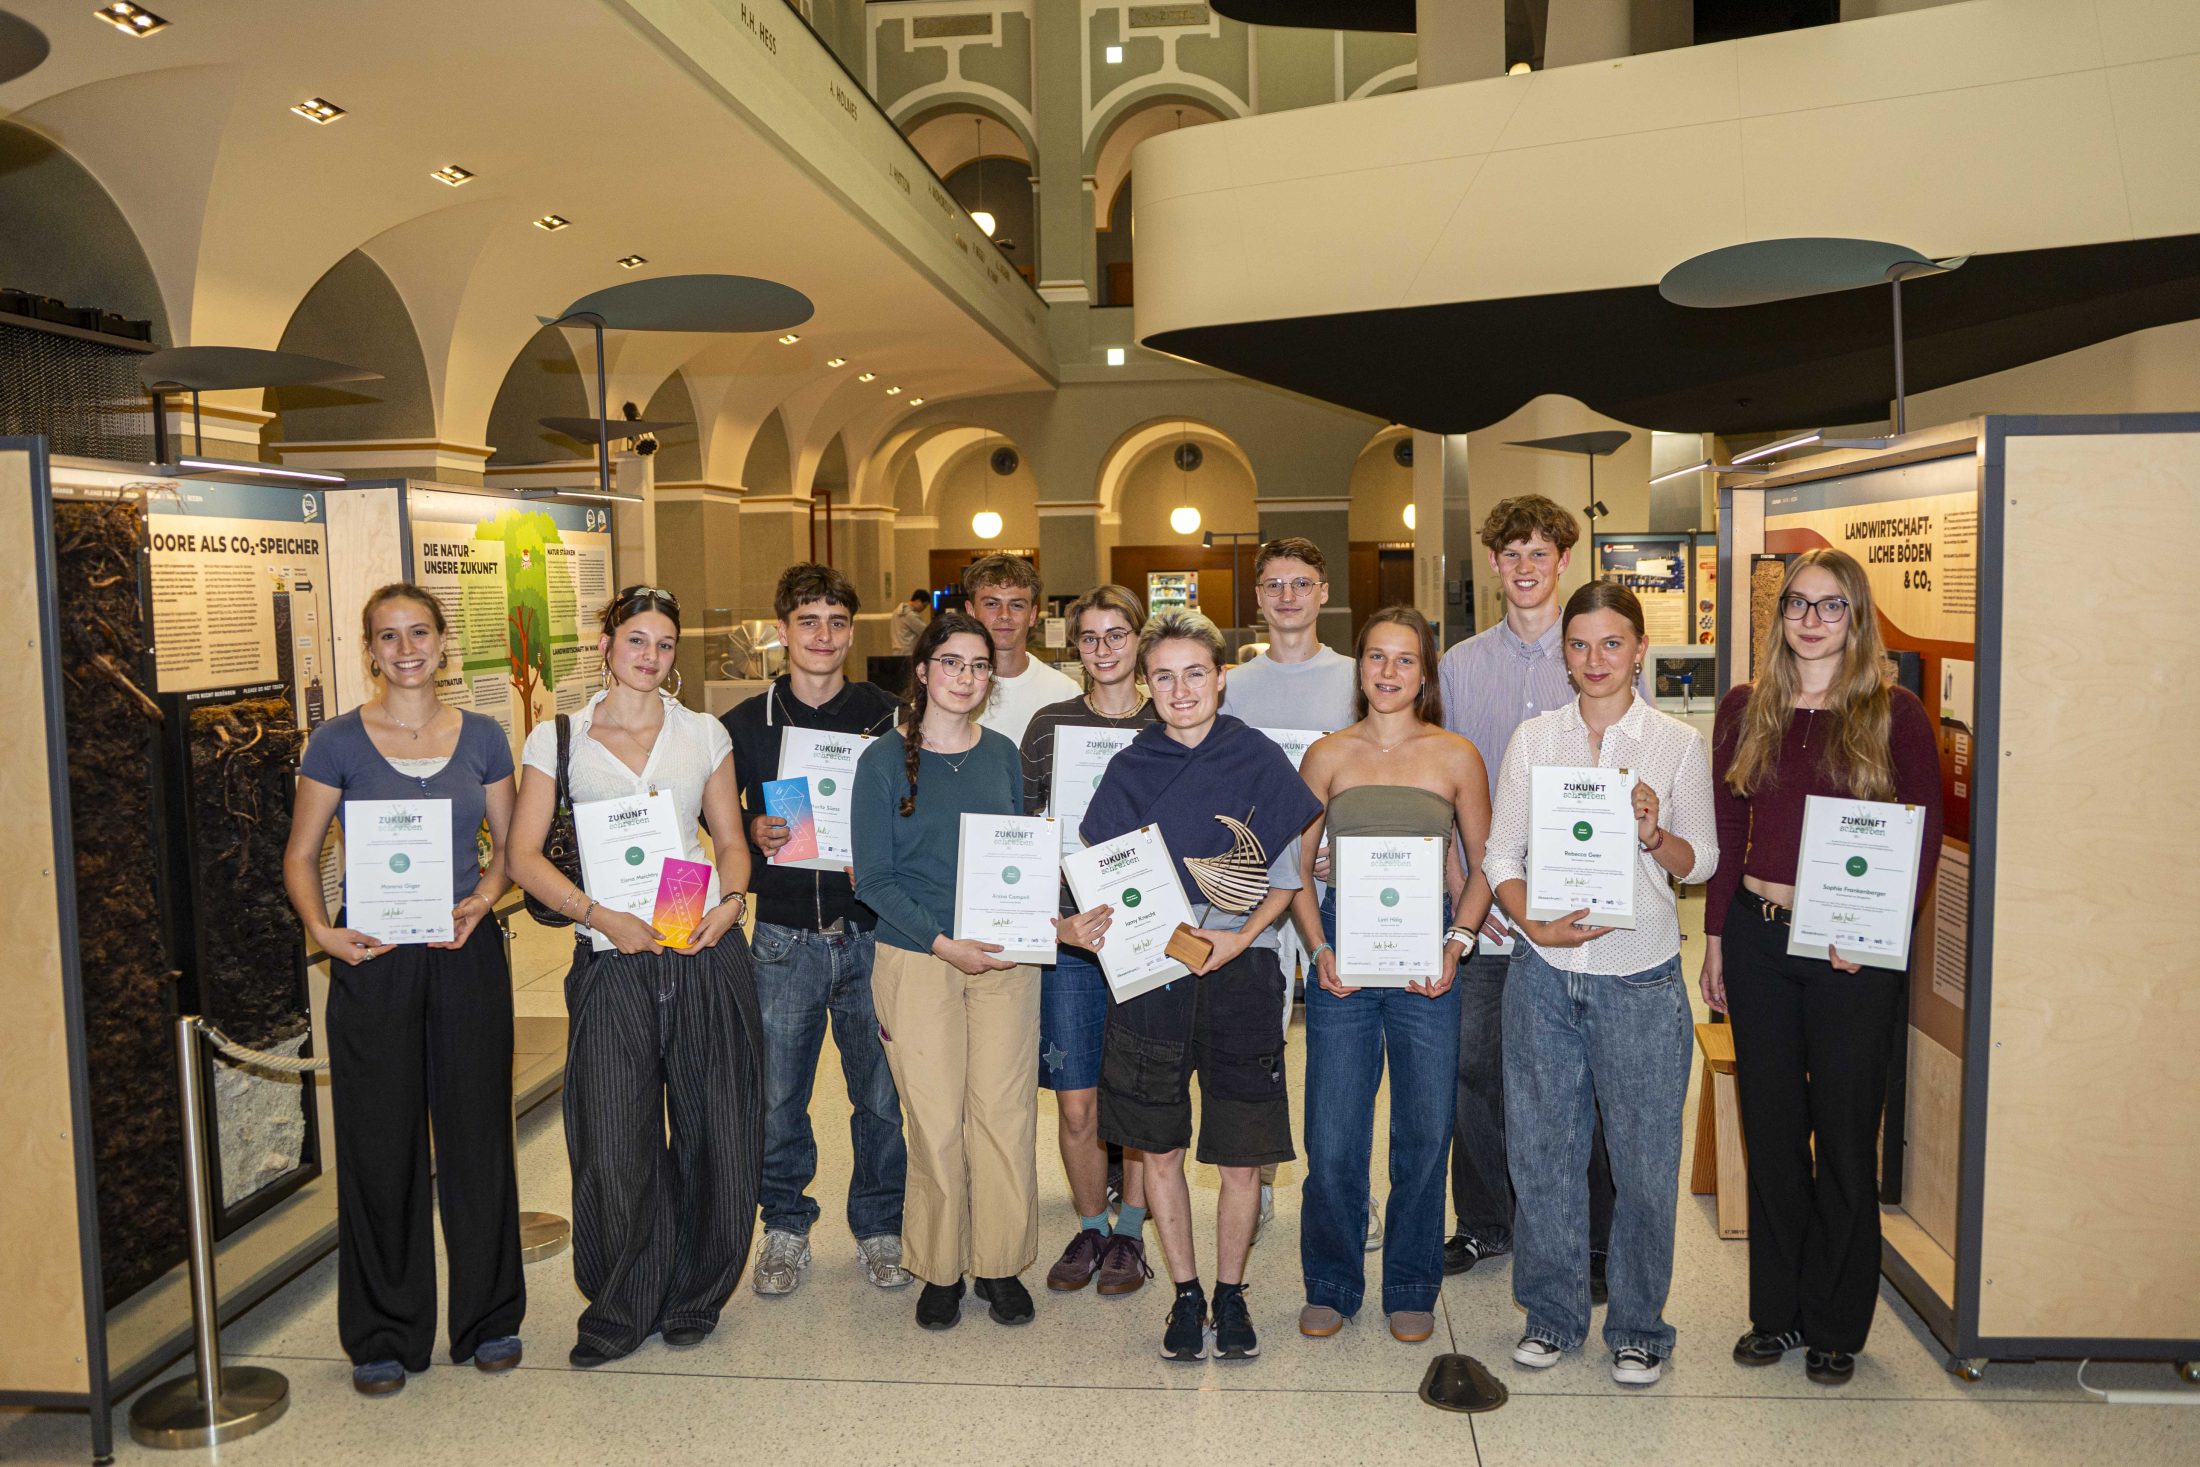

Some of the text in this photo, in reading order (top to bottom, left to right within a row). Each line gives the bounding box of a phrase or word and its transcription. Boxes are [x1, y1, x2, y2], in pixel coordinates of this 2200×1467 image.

[741, 2, 777, 55] H.H. HESS
[836, 85, 858, 121] HOLMES
[149, 533, 196, 553] OORE
[200, 536, 227, 553] ALS
[424, 543, 439, 557] DIE
[441, 544, 470, 558] NATUR
[1869, 539, 1932, 564] LICHE BÖDEN
[425, 561, 498, 575] UNSERE ZUKUNFT
[1904, 572, 1911, 589] &
[435, 677, 463, 688] TADTNATUR
[814, 743, 853, 755] ZUKUNFT
[1563, 783, 1606, 792] ZUKUNFT
[378, 815, 423, 824] ZUKUNFT
[608, 808, 649, 823] ZUKUNFT
[1841, 816, 1888, 828] ZUKUNFT
[994, 830, 1035, 839] ZUKUNFT
[1098, 848, 1136, 868] ZUKUNFT
[1371, 852, 1412, 860] ZUKUNFT
[1823, 883, 1886, 897] Sophie Frankenberger
